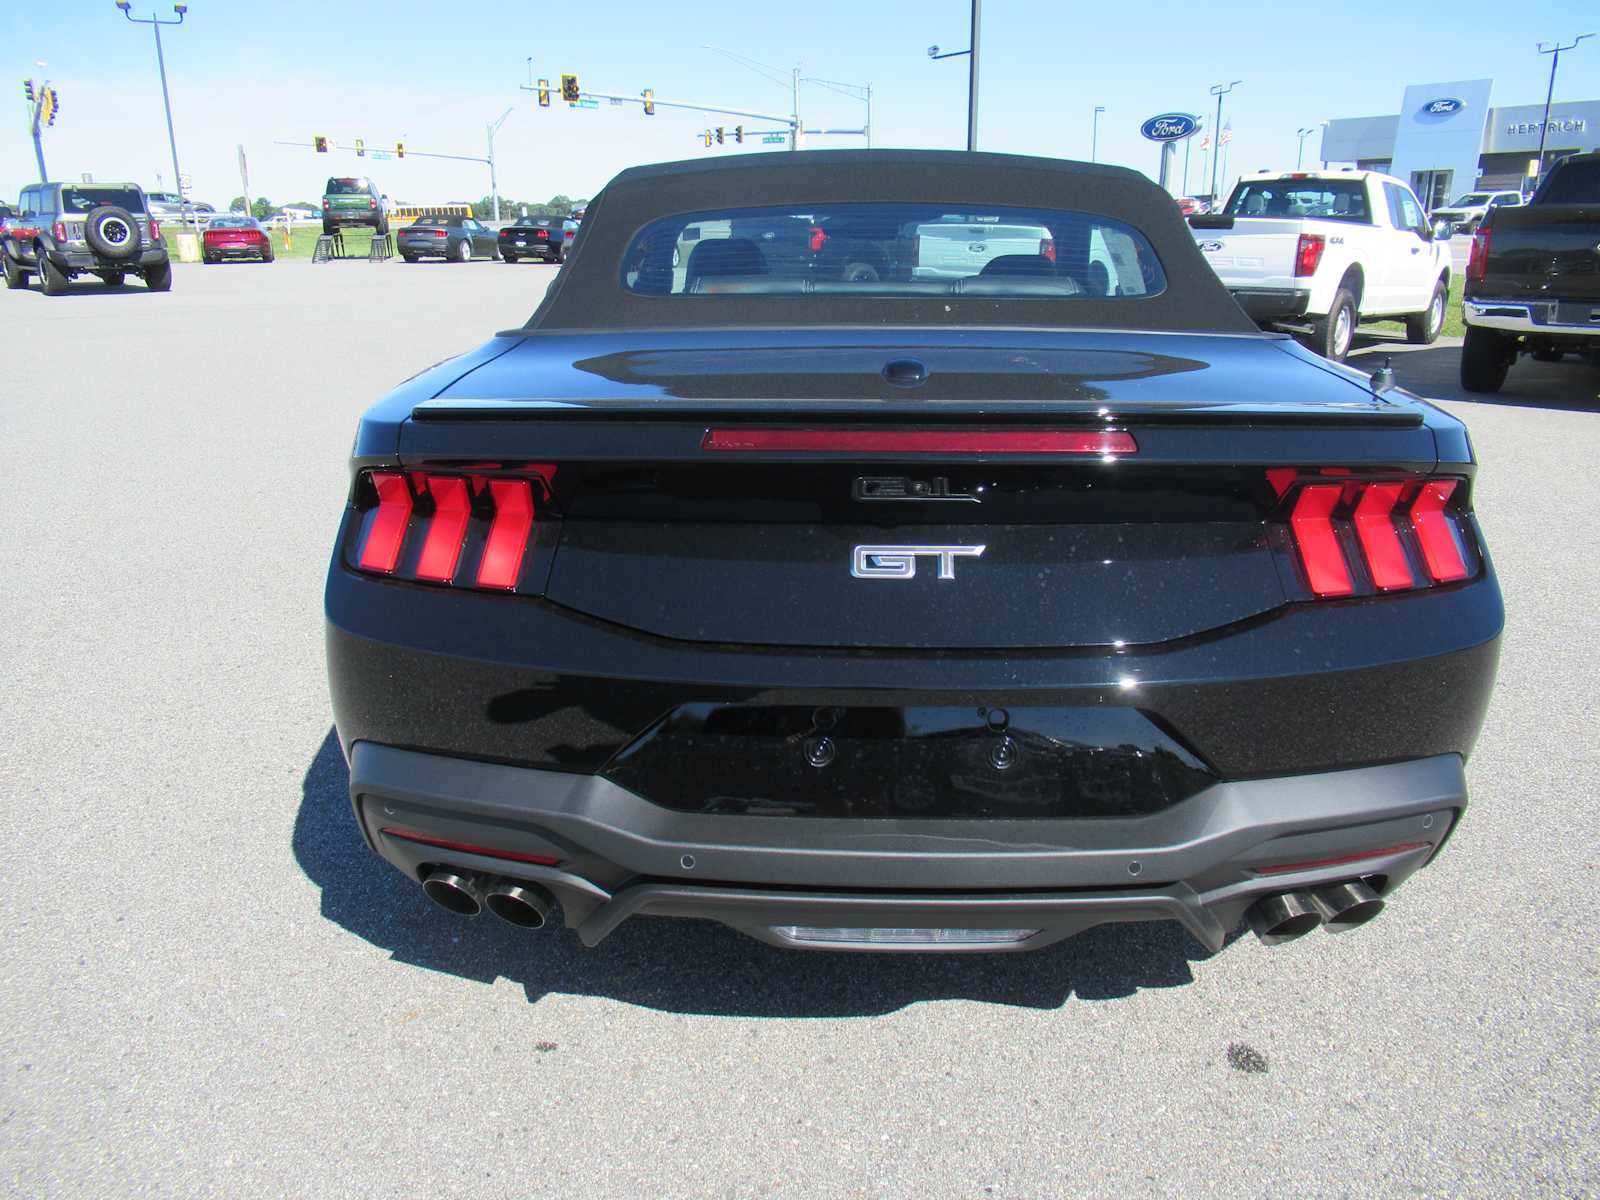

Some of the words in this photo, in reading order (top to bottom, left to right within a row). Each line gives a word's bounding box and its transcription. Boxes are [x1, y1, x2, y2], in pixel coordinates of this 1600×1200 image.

[1430, 101, 1456, 112] Ford
[1152, 118, 1185, 136] Ford
[850, 544, 986, 579] GT
